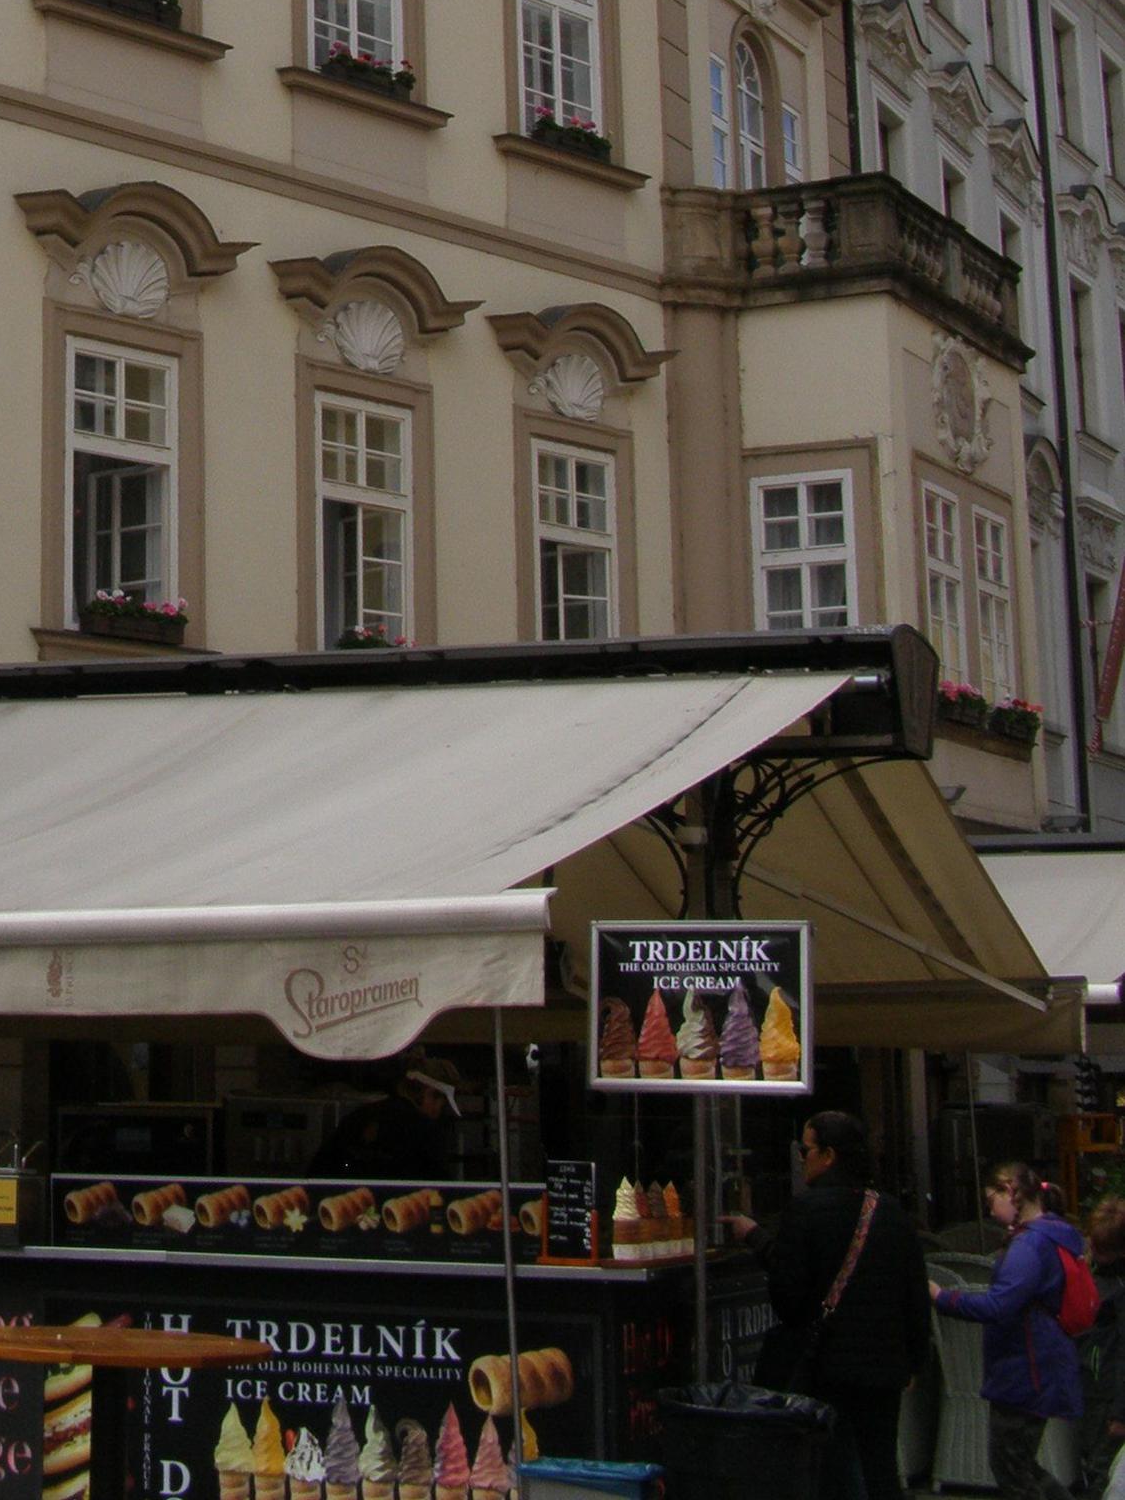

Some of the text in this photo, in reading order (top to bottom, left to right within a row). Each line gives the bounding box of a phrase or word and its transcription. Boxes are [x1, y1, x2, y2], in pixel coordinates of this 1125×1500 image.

[628, 935, 772, 963] TRDELNÍK
[618, 962, 781, 973] THE OLD BOHEMIA SPECIALITY
[653, 975, 742, 991] ICE CREAM
[284, 967, 424, 1039] Staropramen
[225, 1318, 463, 1362] TRDELNÍK
[291, 1361, 374, 1378] BOHEMIAN
[376, 1364, 464, 1382] SPECIALITY
[224, 1378, 373, 1406] ICE CREAM
